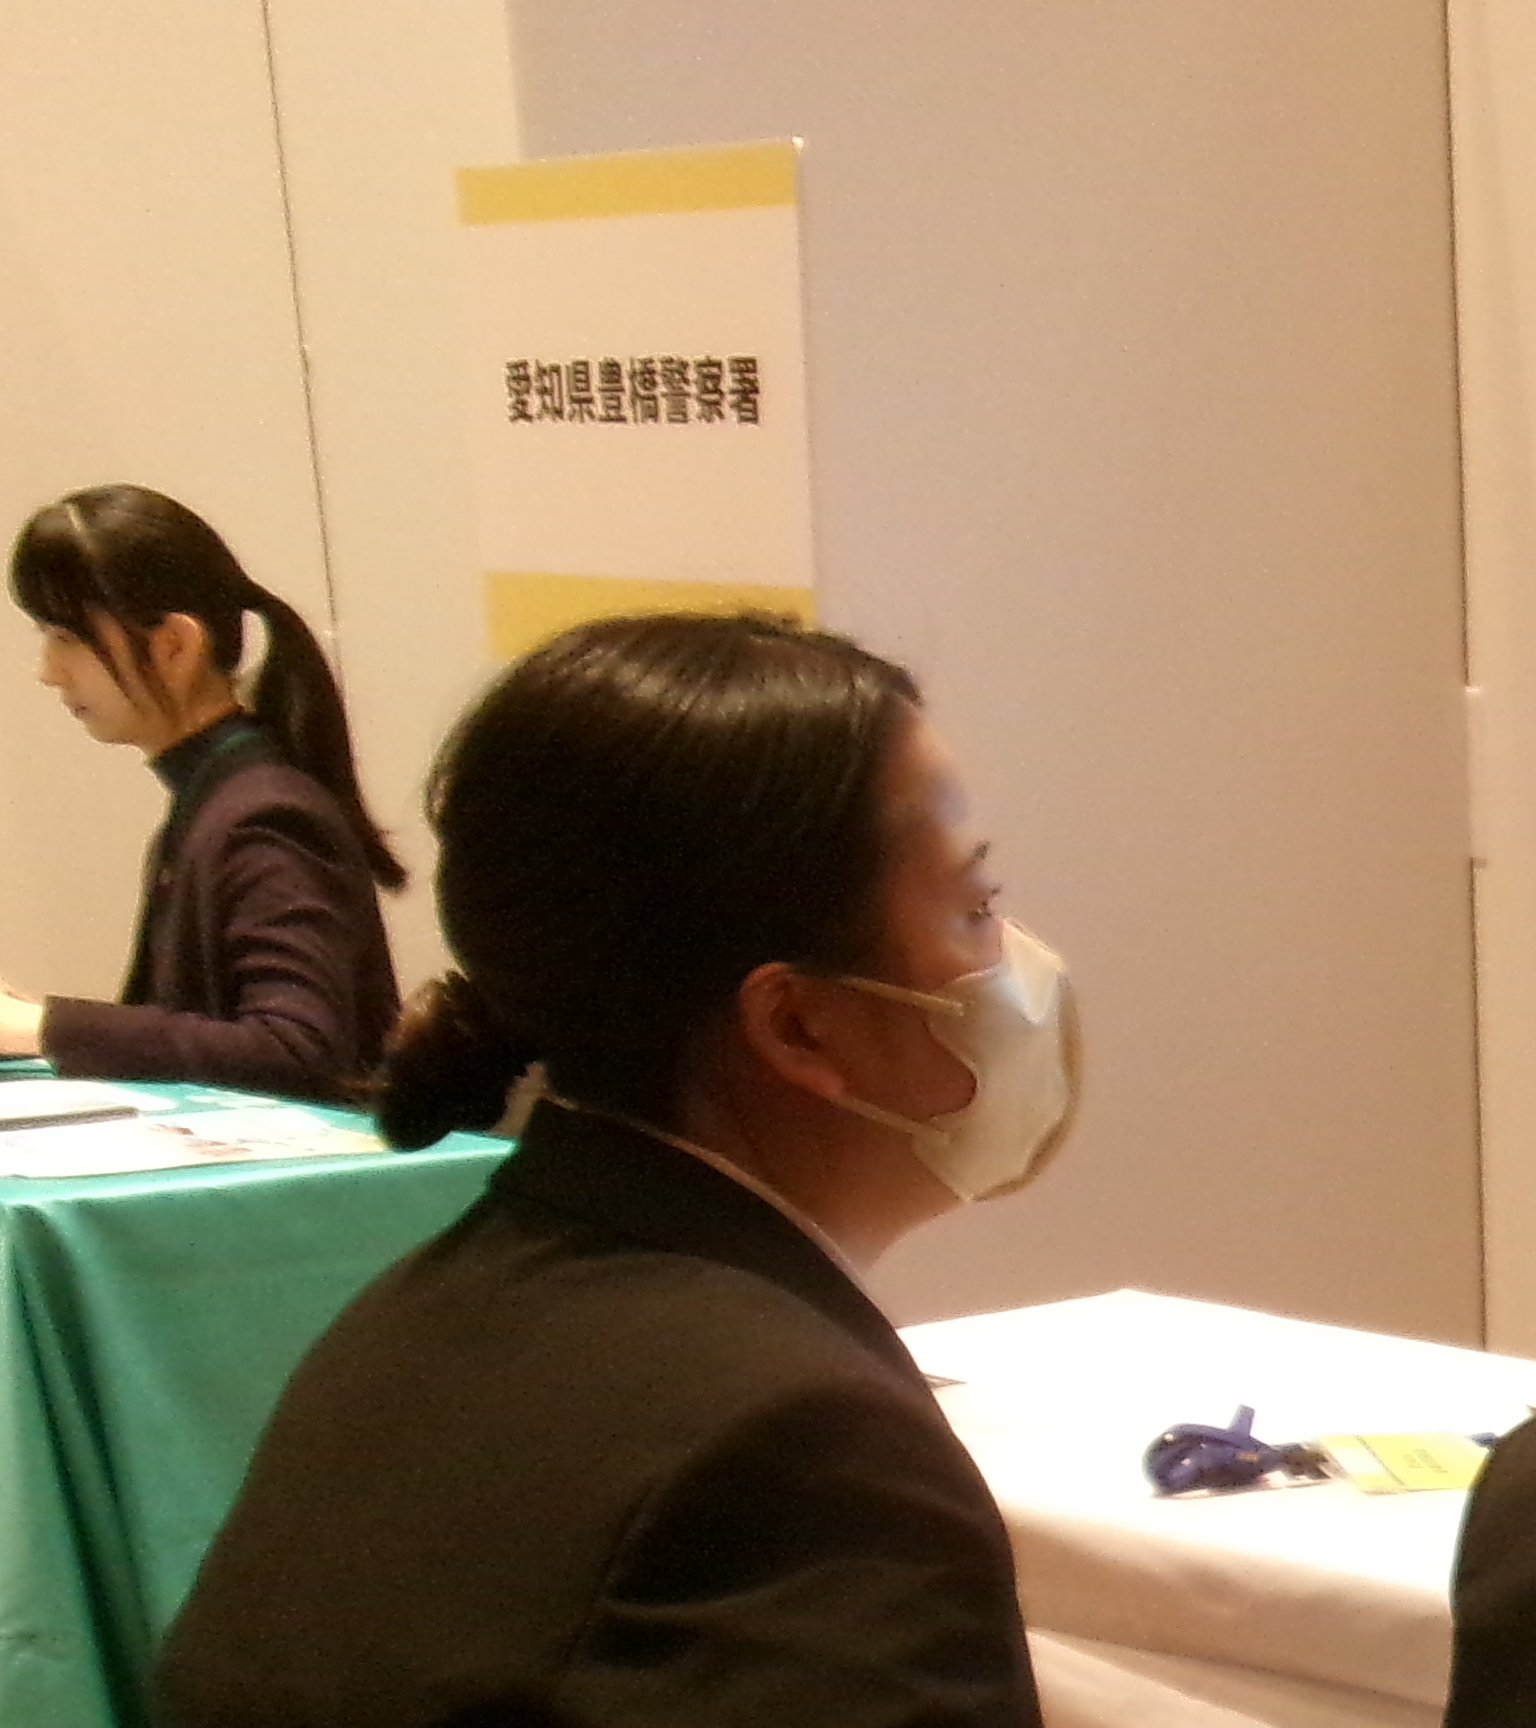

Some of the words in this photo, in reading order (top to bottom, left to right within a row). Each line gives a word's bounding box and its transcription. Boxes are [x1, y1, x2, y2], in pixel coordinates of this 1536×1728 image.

[504, 354, 761, 424] 愛知県豊橋警察署
